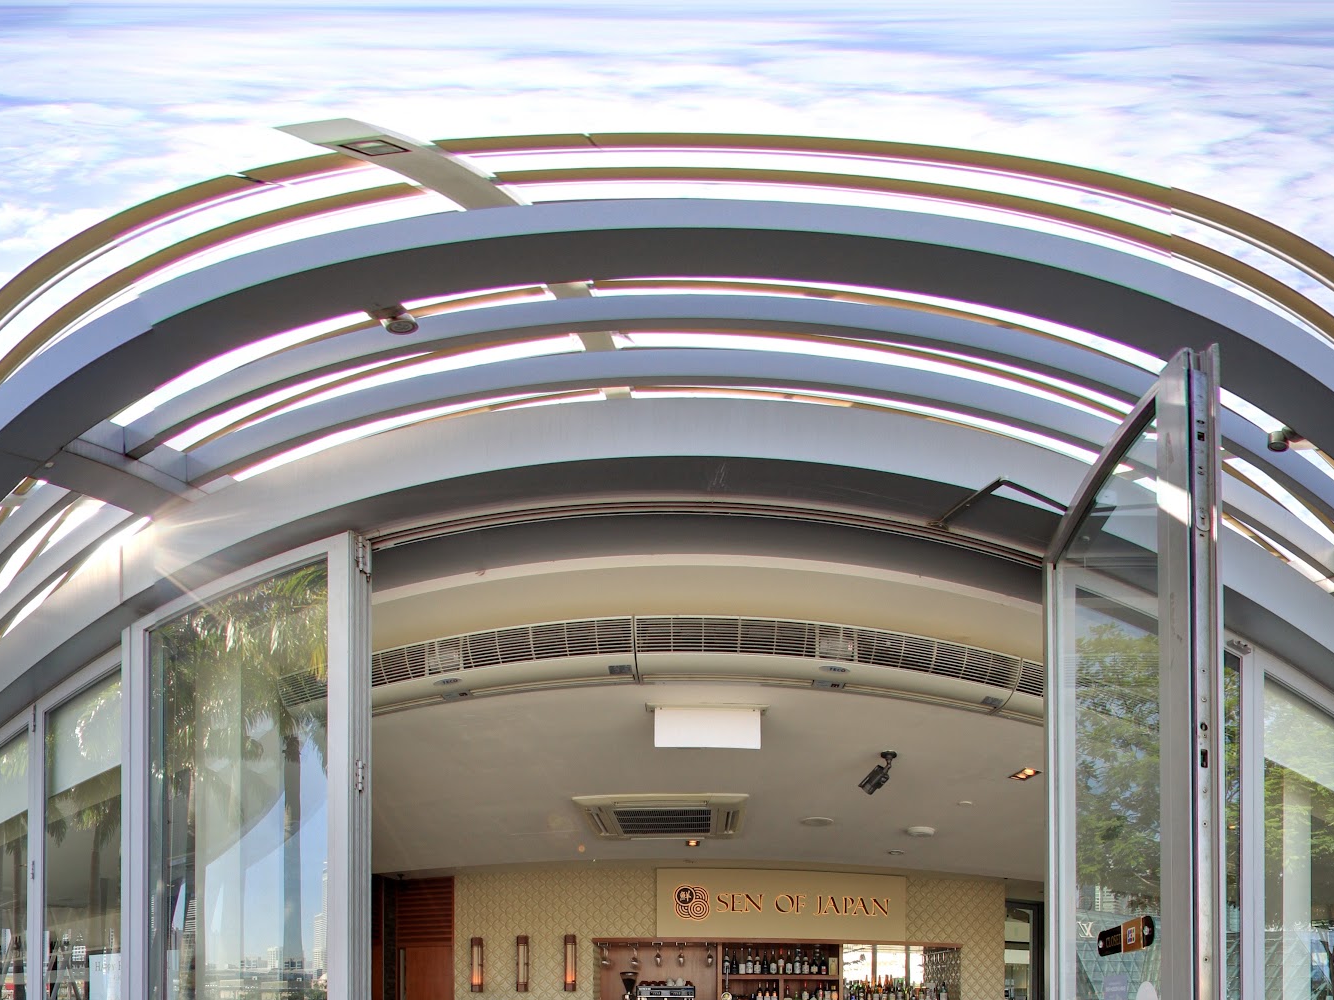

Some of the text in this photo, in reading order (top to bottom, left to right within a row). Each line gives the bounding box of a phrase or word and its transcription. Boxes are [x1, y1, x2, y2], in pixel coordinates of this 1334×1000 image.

[717, 893, 891, 917] SEN OF JAPAN
